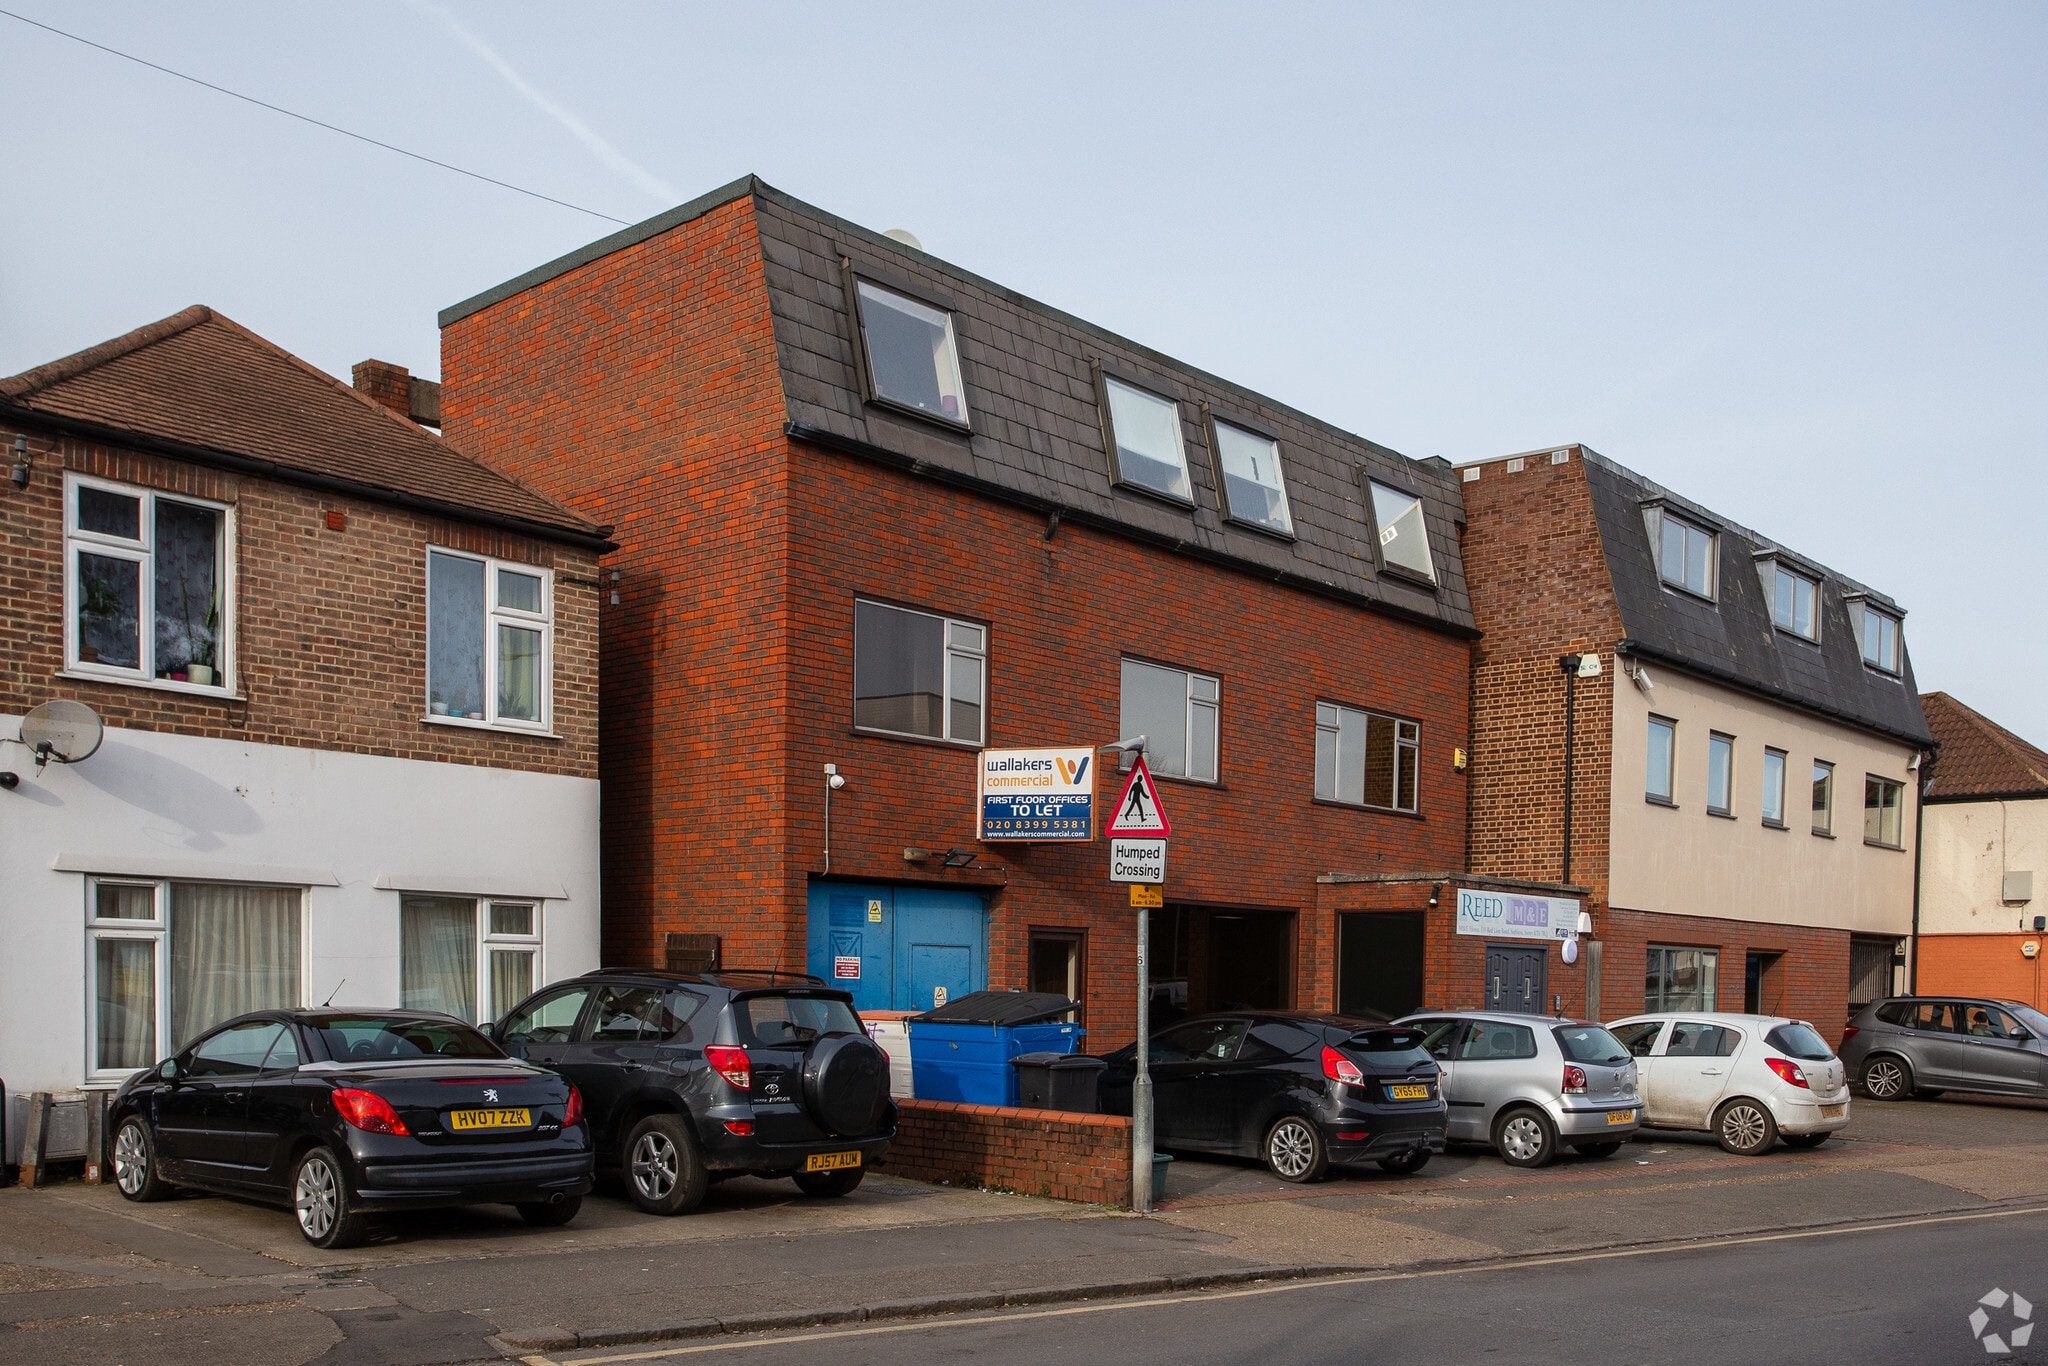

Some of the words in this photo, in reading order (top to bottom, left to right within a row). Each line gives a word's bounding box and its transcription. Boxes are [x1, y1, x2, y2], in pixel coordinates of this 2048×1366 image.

[987, 757, 1053, 771] wallakers
[986, 773, 1053, 787] commercial
[987, 796, 1014, 805] FIRST
[1015, 796, 1046, 804] FLOOR
[1048, 795, 1088, 804] OFFICES
[1010, 804, 1031, 816] TO
[1035, 804, 1064, 817] LET
[987, 820, 1011, 829] 020
[1015, 820, 1048, 829] 8399
[1053, 820, 1086, 829] 5381
[1116, 844, 1161, 861] Humped
[1114, 862, 1161, 879] Crossing
[1462, 893, 1503, 922] REED
[1393, 1085, 1413, 1097] GY65
[1413, 1085, 1427, 1096] FHX
[458, 1111, 495, 1126] HV07
[499, 1110, 526, 1124] ZZK
[811, 1155, 837, 1169] RJ57
[840, 1153, 858, 1167] AUM
